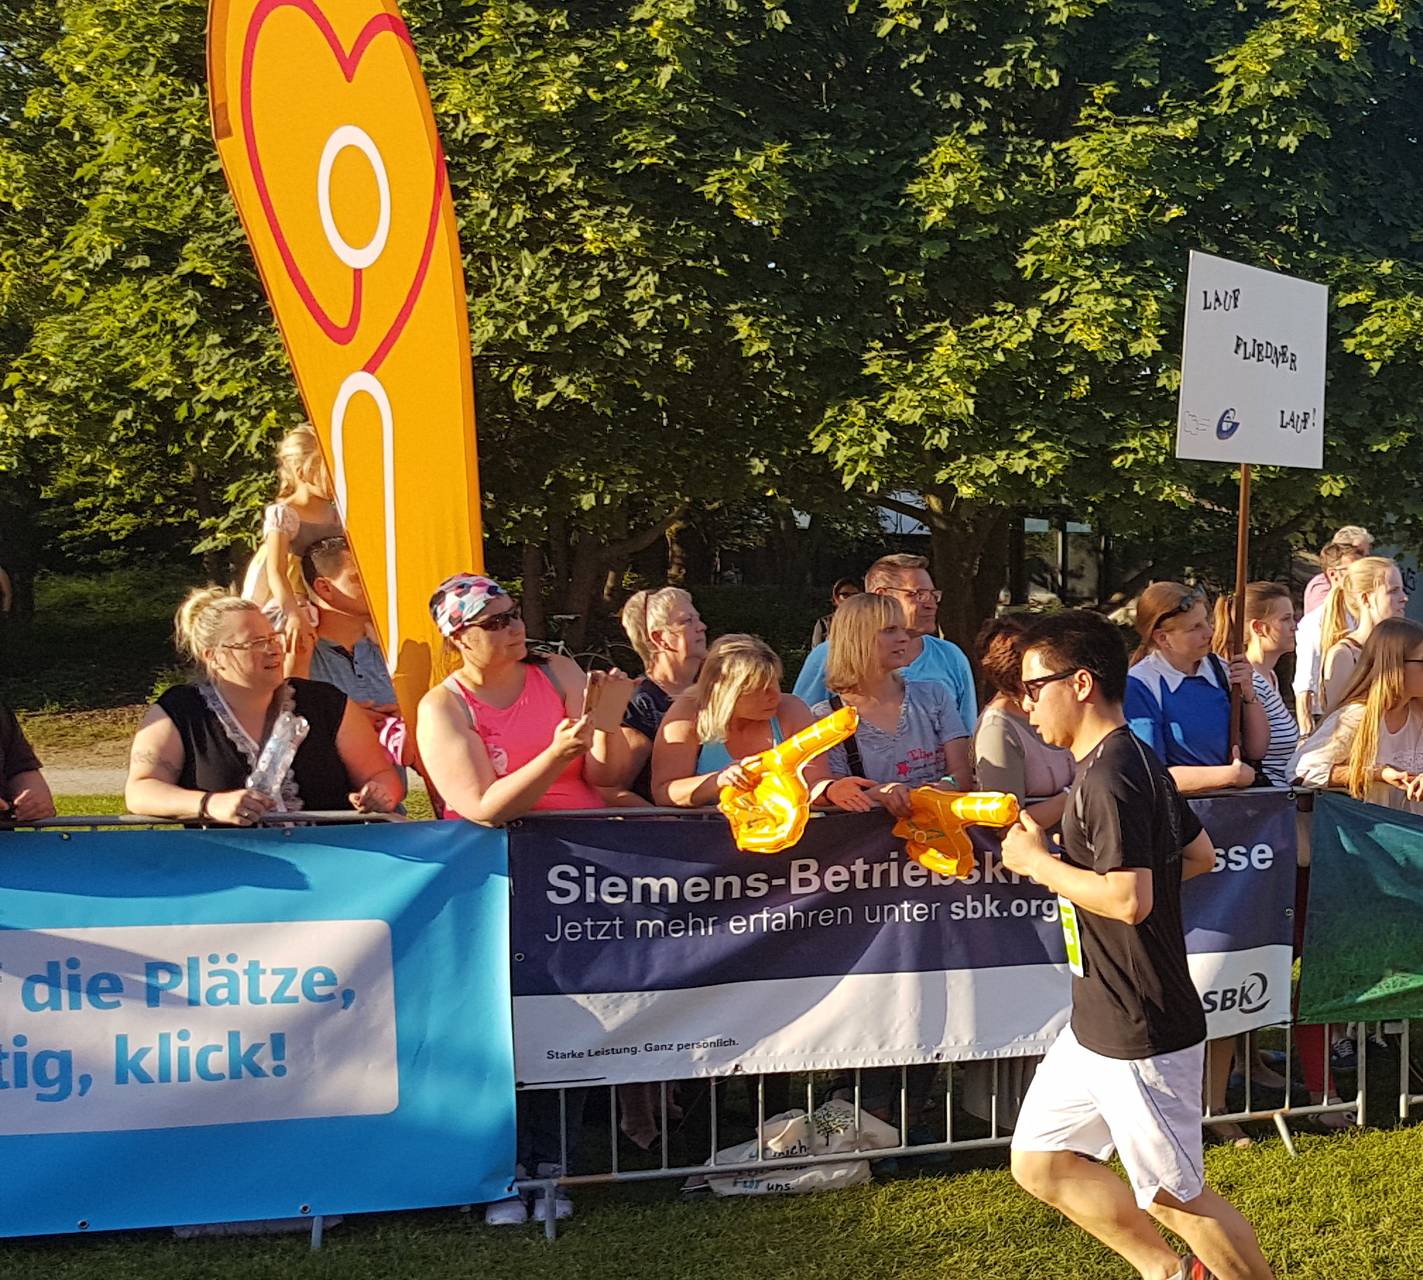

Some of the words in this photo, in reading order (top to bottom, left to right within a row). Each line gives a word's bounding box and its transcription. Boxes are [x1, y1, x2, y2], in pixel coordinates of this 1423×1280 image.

[1203, 288, 1241, 311] LAUF
[1233, 335, 1297, 371] FLIEDNER
[1280, 408, 1316, 433] LAUF!
[545, 915, 624, 942] Jetzt
[636, 912, 718, 938] mehr
[729, 906, 852, 934] erfahren
[865, 900, 940, 923] unter
[950, 894, 1059, 922] sbk.org
[21, 956, 125, 1013] die
[145, 952, 356, 1011] Plätze,
[1202, 980, 1257, 1014] SBK
[115, 1028, 288, 1085] klick!
[546, 1050, 584, 1060] Starke
[588, 1046, 641, 1058] Leistung.
[644, 1042, 674, 1053] Ganz
